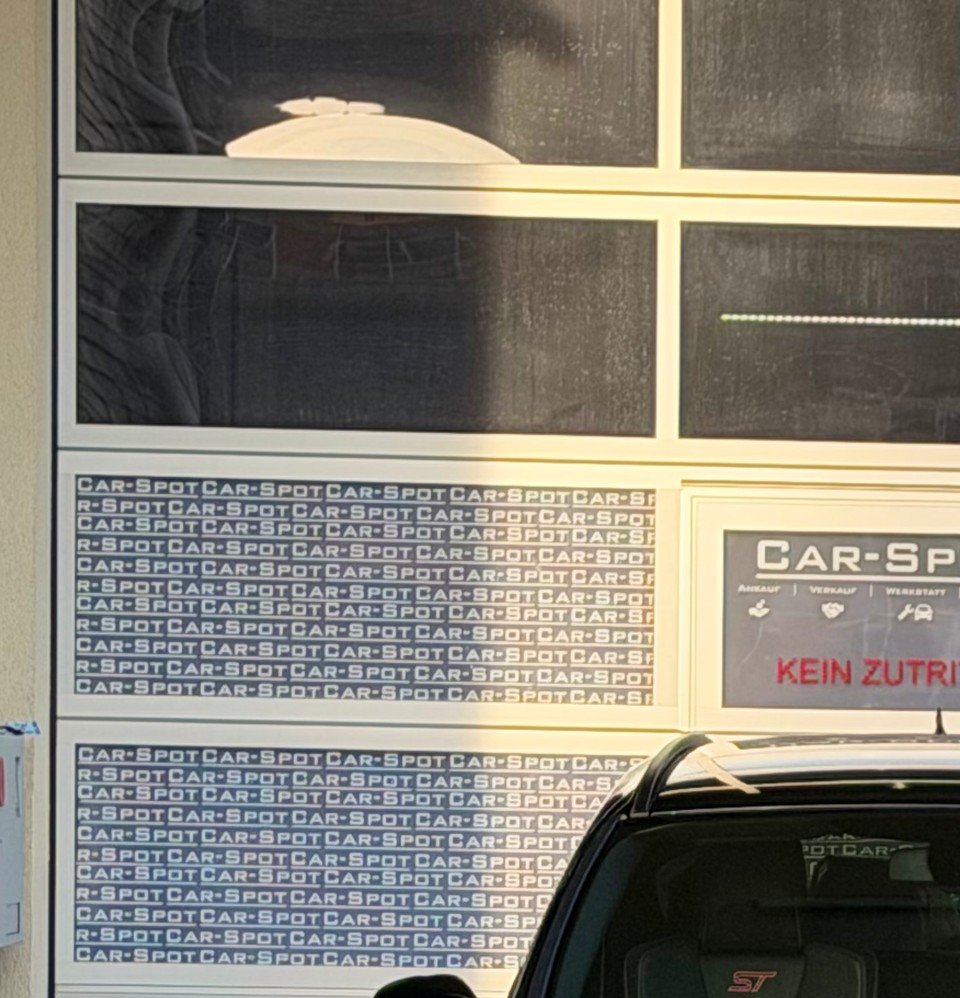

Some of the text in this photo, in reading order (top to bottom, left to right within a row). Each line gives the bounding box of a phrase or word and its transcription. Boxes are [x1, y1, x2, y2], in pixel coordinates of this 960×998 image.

[809, 585, 857, 595] VERKAUF
[777, 658, 851, 685] KEIN
[727, 971, 777, 993] ST
